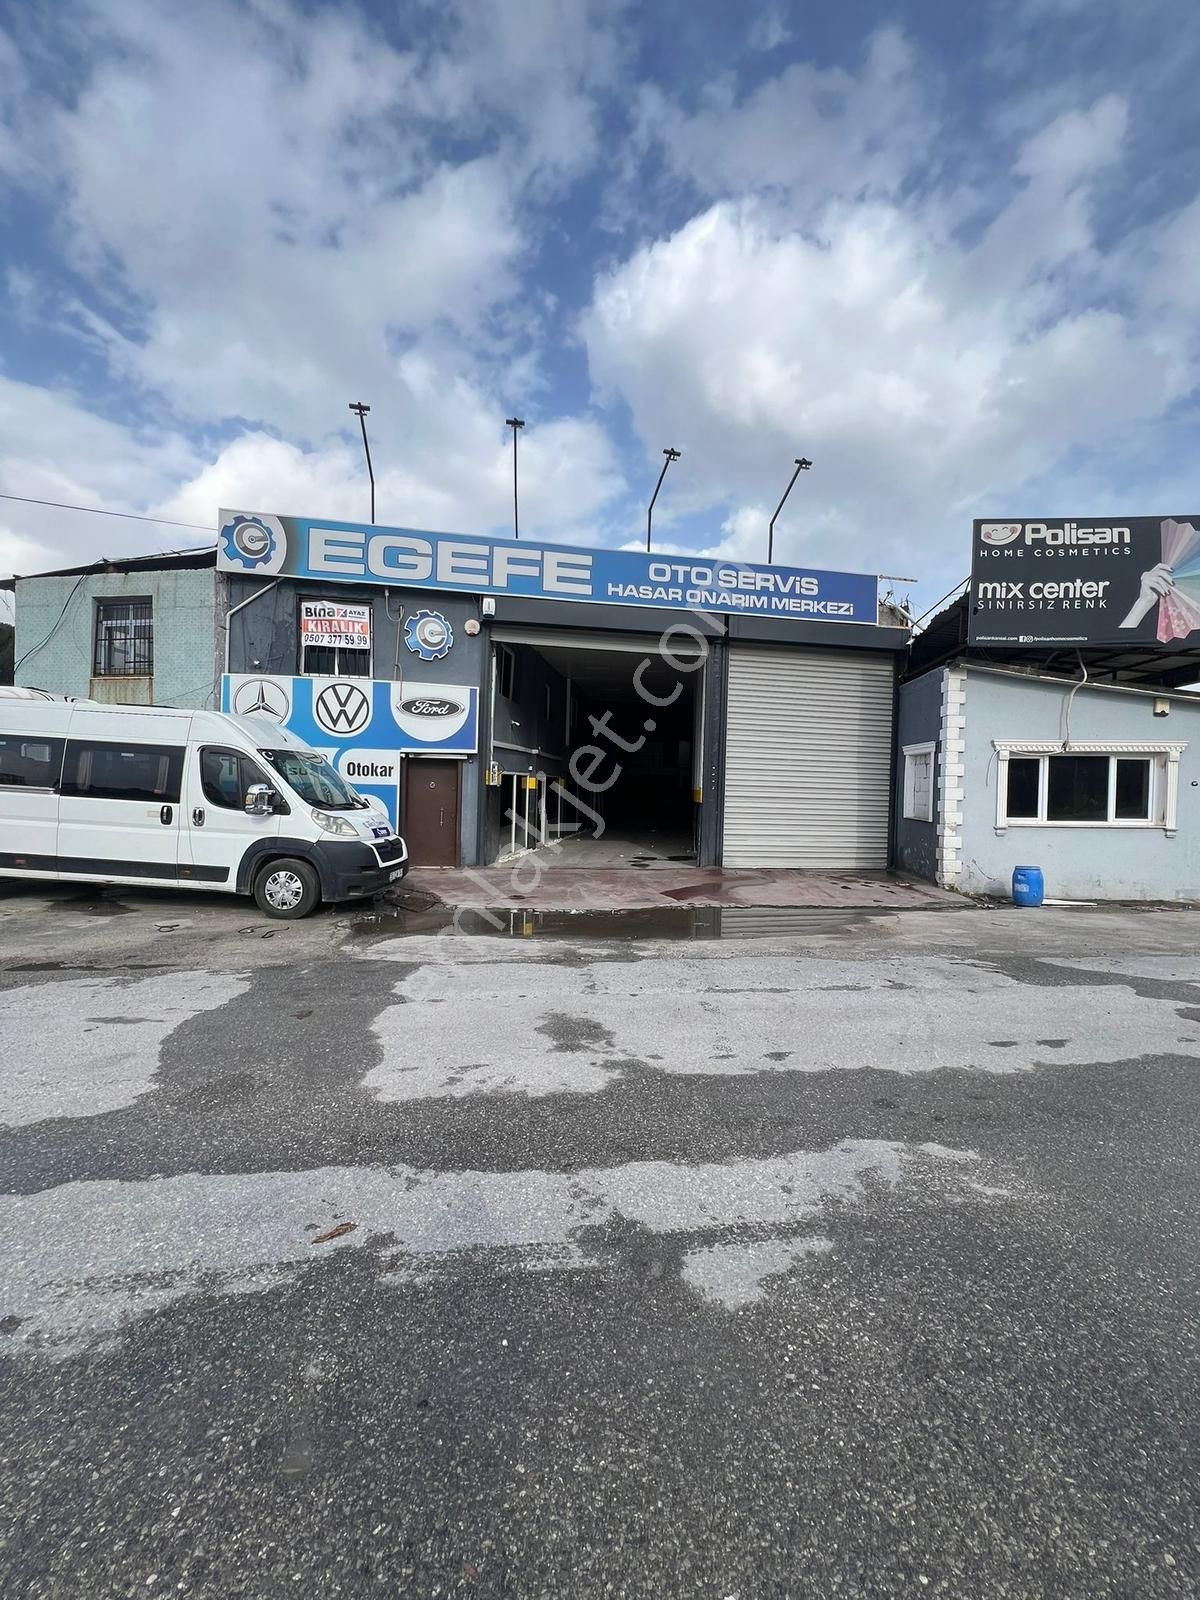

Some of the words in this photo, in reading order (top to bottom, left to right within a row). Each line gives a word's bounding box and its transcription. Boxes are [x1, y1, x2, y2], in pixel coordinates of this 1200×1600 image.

[1024, 523, 1131, 545] Polisan
[980, 549, 1024, 557] HOME
[1034, 547, 1131, 557] COSMETICS
[307, 527, 593, 596] EGEFE
[648, 562, 713, 586] OTO
[607, 582, 682, 602] HASAR
[685, 588, 768, 609] ONARIM
[978, 581, 1024, 599] mix
[1029, 578, 1110, 599] center
[977, 600, 1055, 610] SINIRSIZ
[1062, 599, 1107, 609] RENK
[308, 620, 364, 634] KIRALIK
[304, 633, 325, 643] 0507
[327, 634, 342, 645] 377
[345, 634, 355, 646] 59
[357, 635, 368, 646] 99
[411, 700, 450, 715] Ford
[346, 761, 394, 777] Otokar
